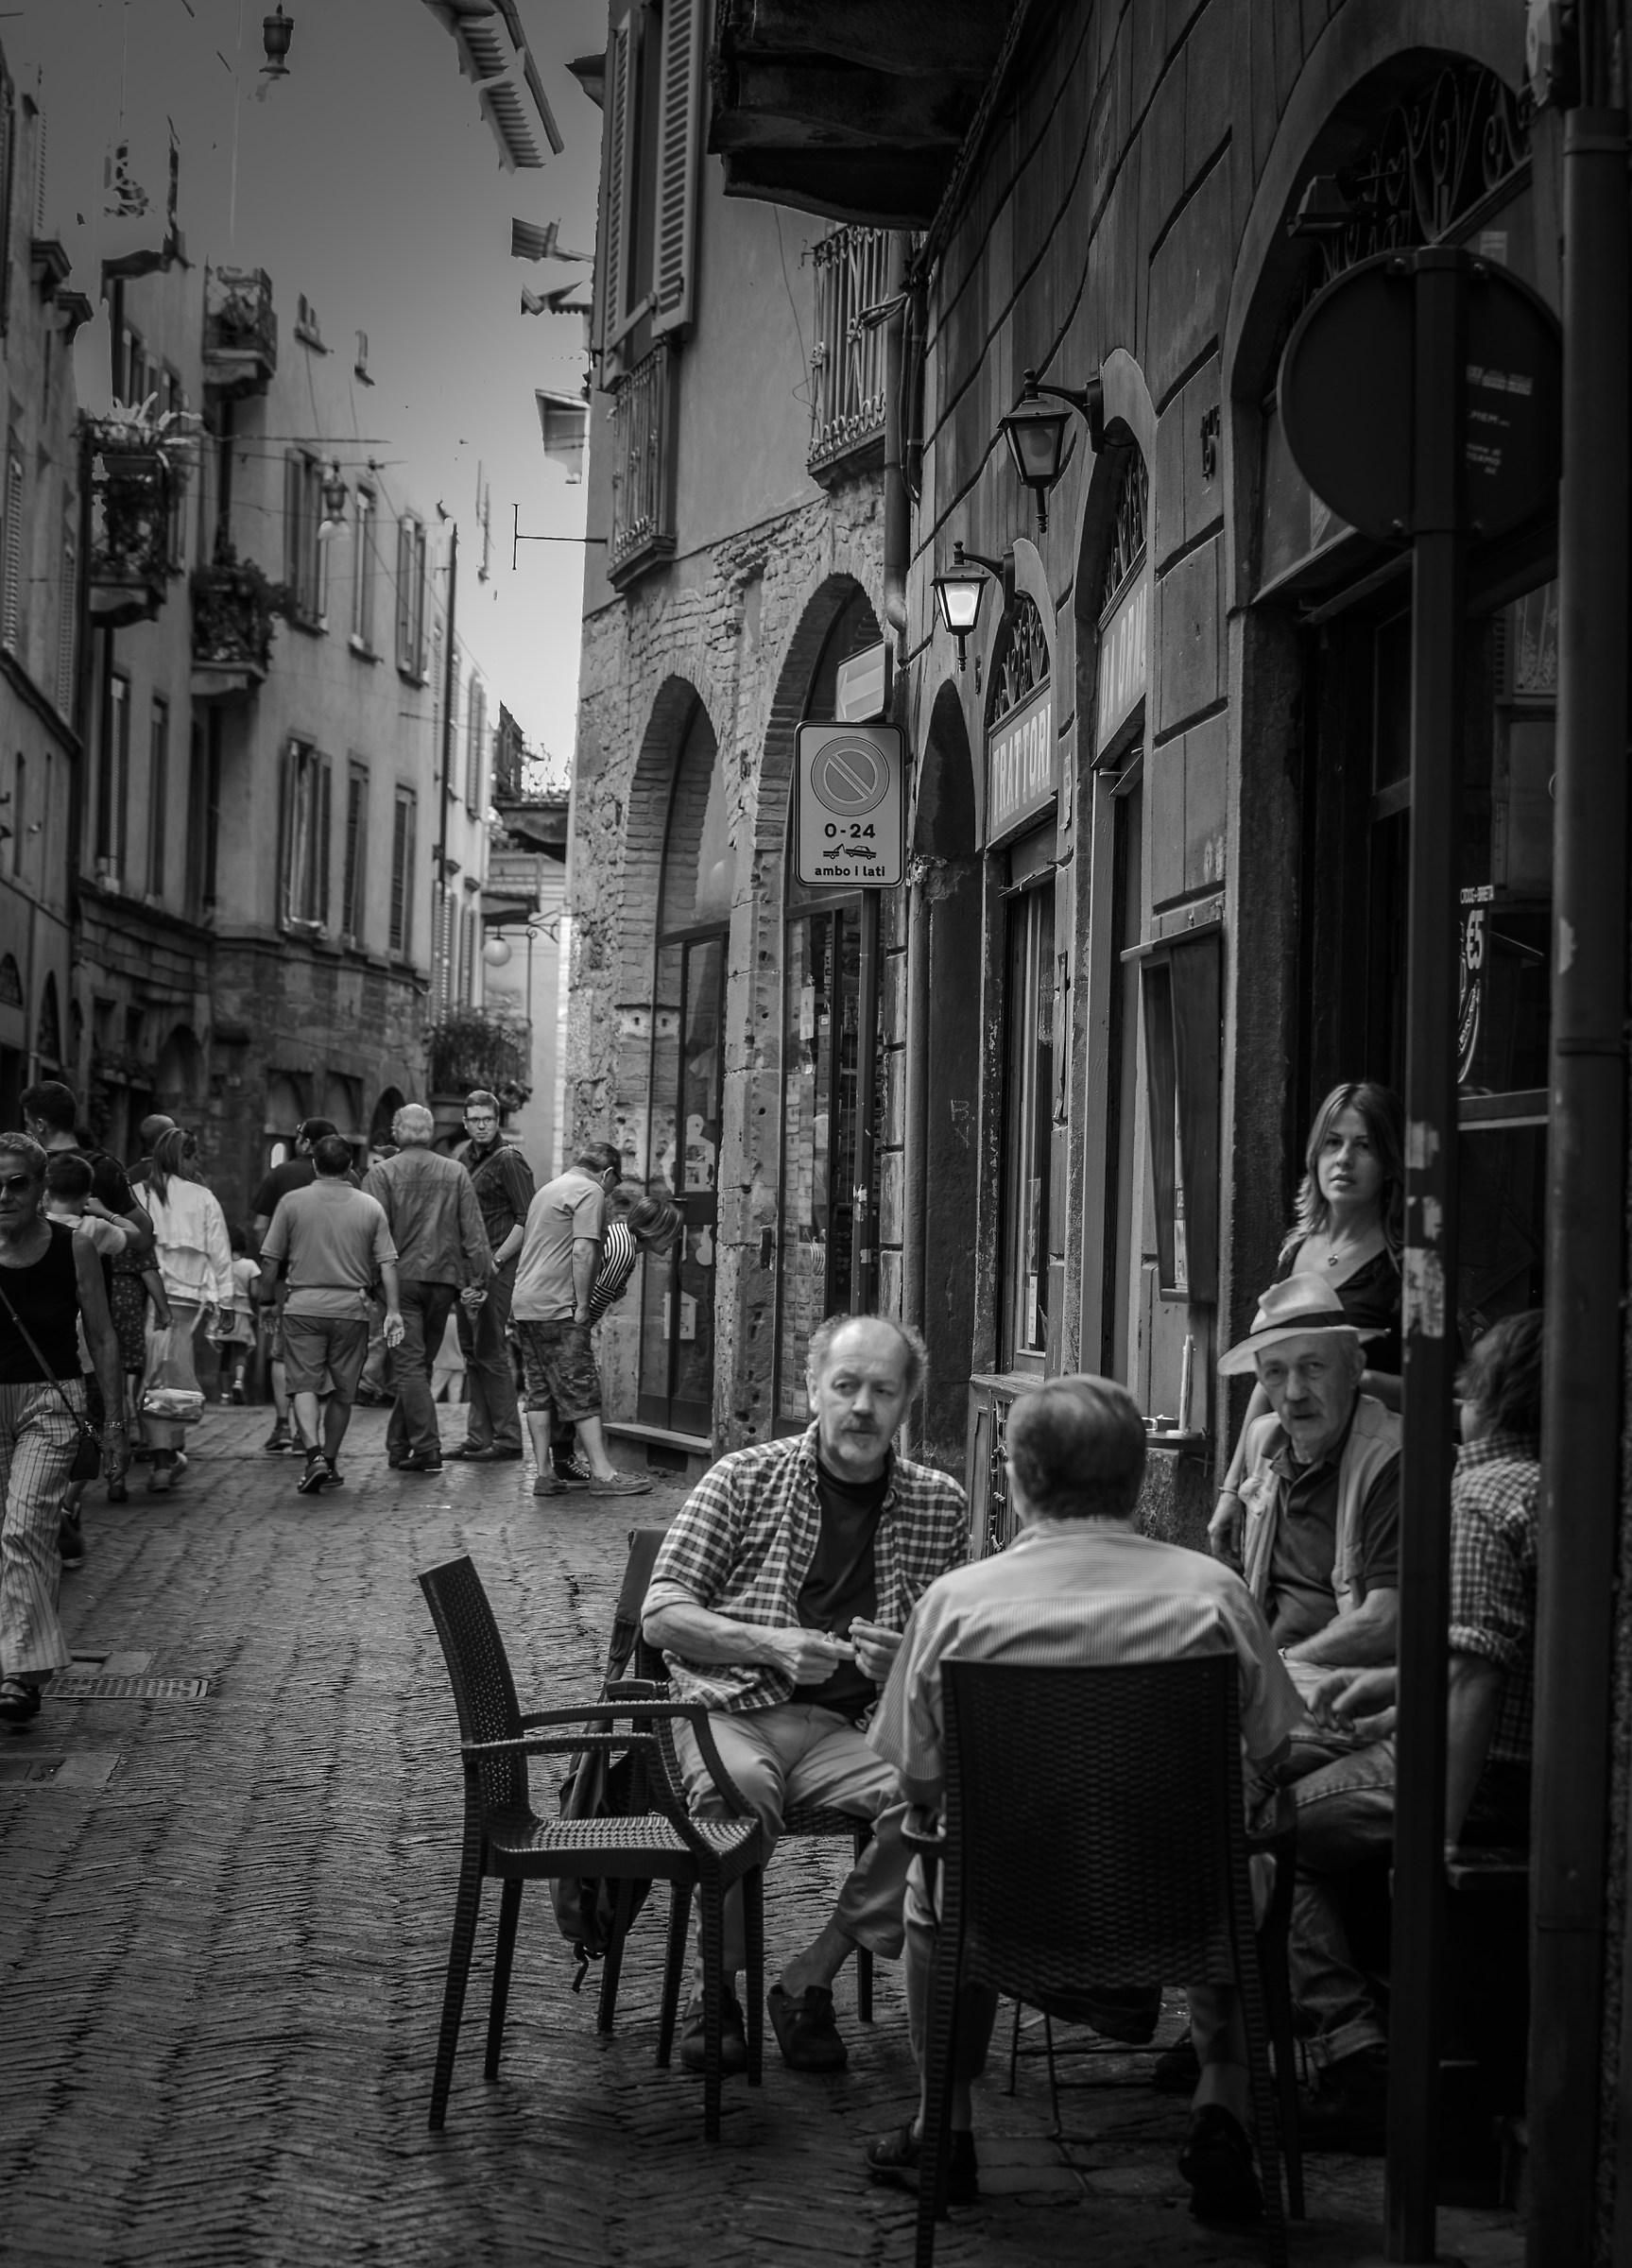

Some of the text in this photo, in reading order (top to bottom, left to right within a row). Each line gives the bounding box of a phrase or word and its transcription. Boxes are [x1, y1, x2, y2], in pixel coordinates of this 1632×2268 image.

[815, 866, 885, 877] ambo i lati
